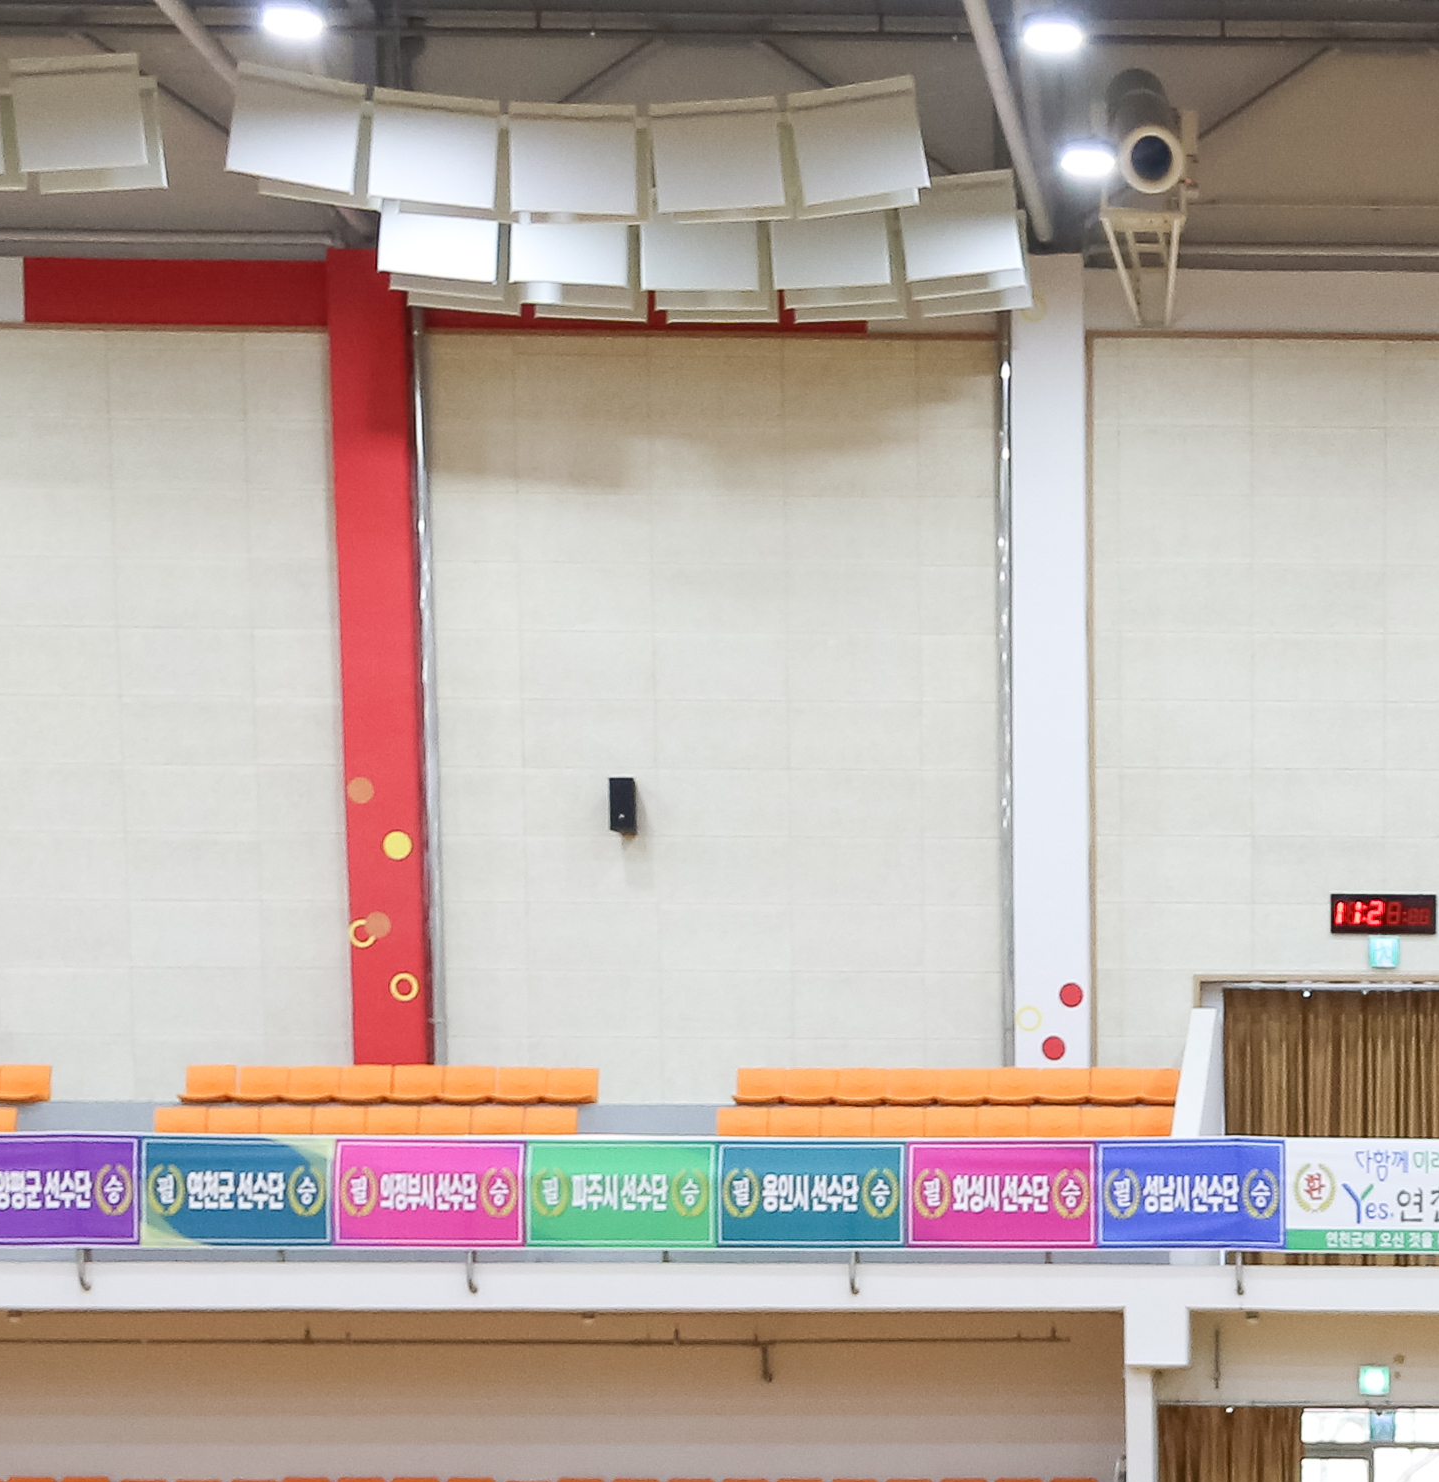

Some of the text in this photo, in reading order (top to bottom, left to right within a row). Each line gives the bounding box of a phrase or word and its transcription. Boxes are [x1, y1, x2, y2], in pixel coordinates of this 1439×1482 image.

[1355, 1150, 1409, 1182] 다함께
[43, 1170, 93, 1209] 선수단
[103, 1174, 124, 1204] 승
[157, 1170, 317, 1210] 필 연천군 선수단 승
[350, 1173, 510, 1211] 필 의정부시 선수단 승
[542, 1173, 701, 1211] 필 파주시 선수단 승
[732, 1173, 891, 1212] 필 용인시 선수단 승
[923, 1174, 1082, 1213] 필 화성시 선수단 승
[1113, 1174, 1271, 1213] 필 성남시 선수단 승
[1303, 1173, 1326, 1200] 환
[1379, 1231, 1405, 1249] 오신
